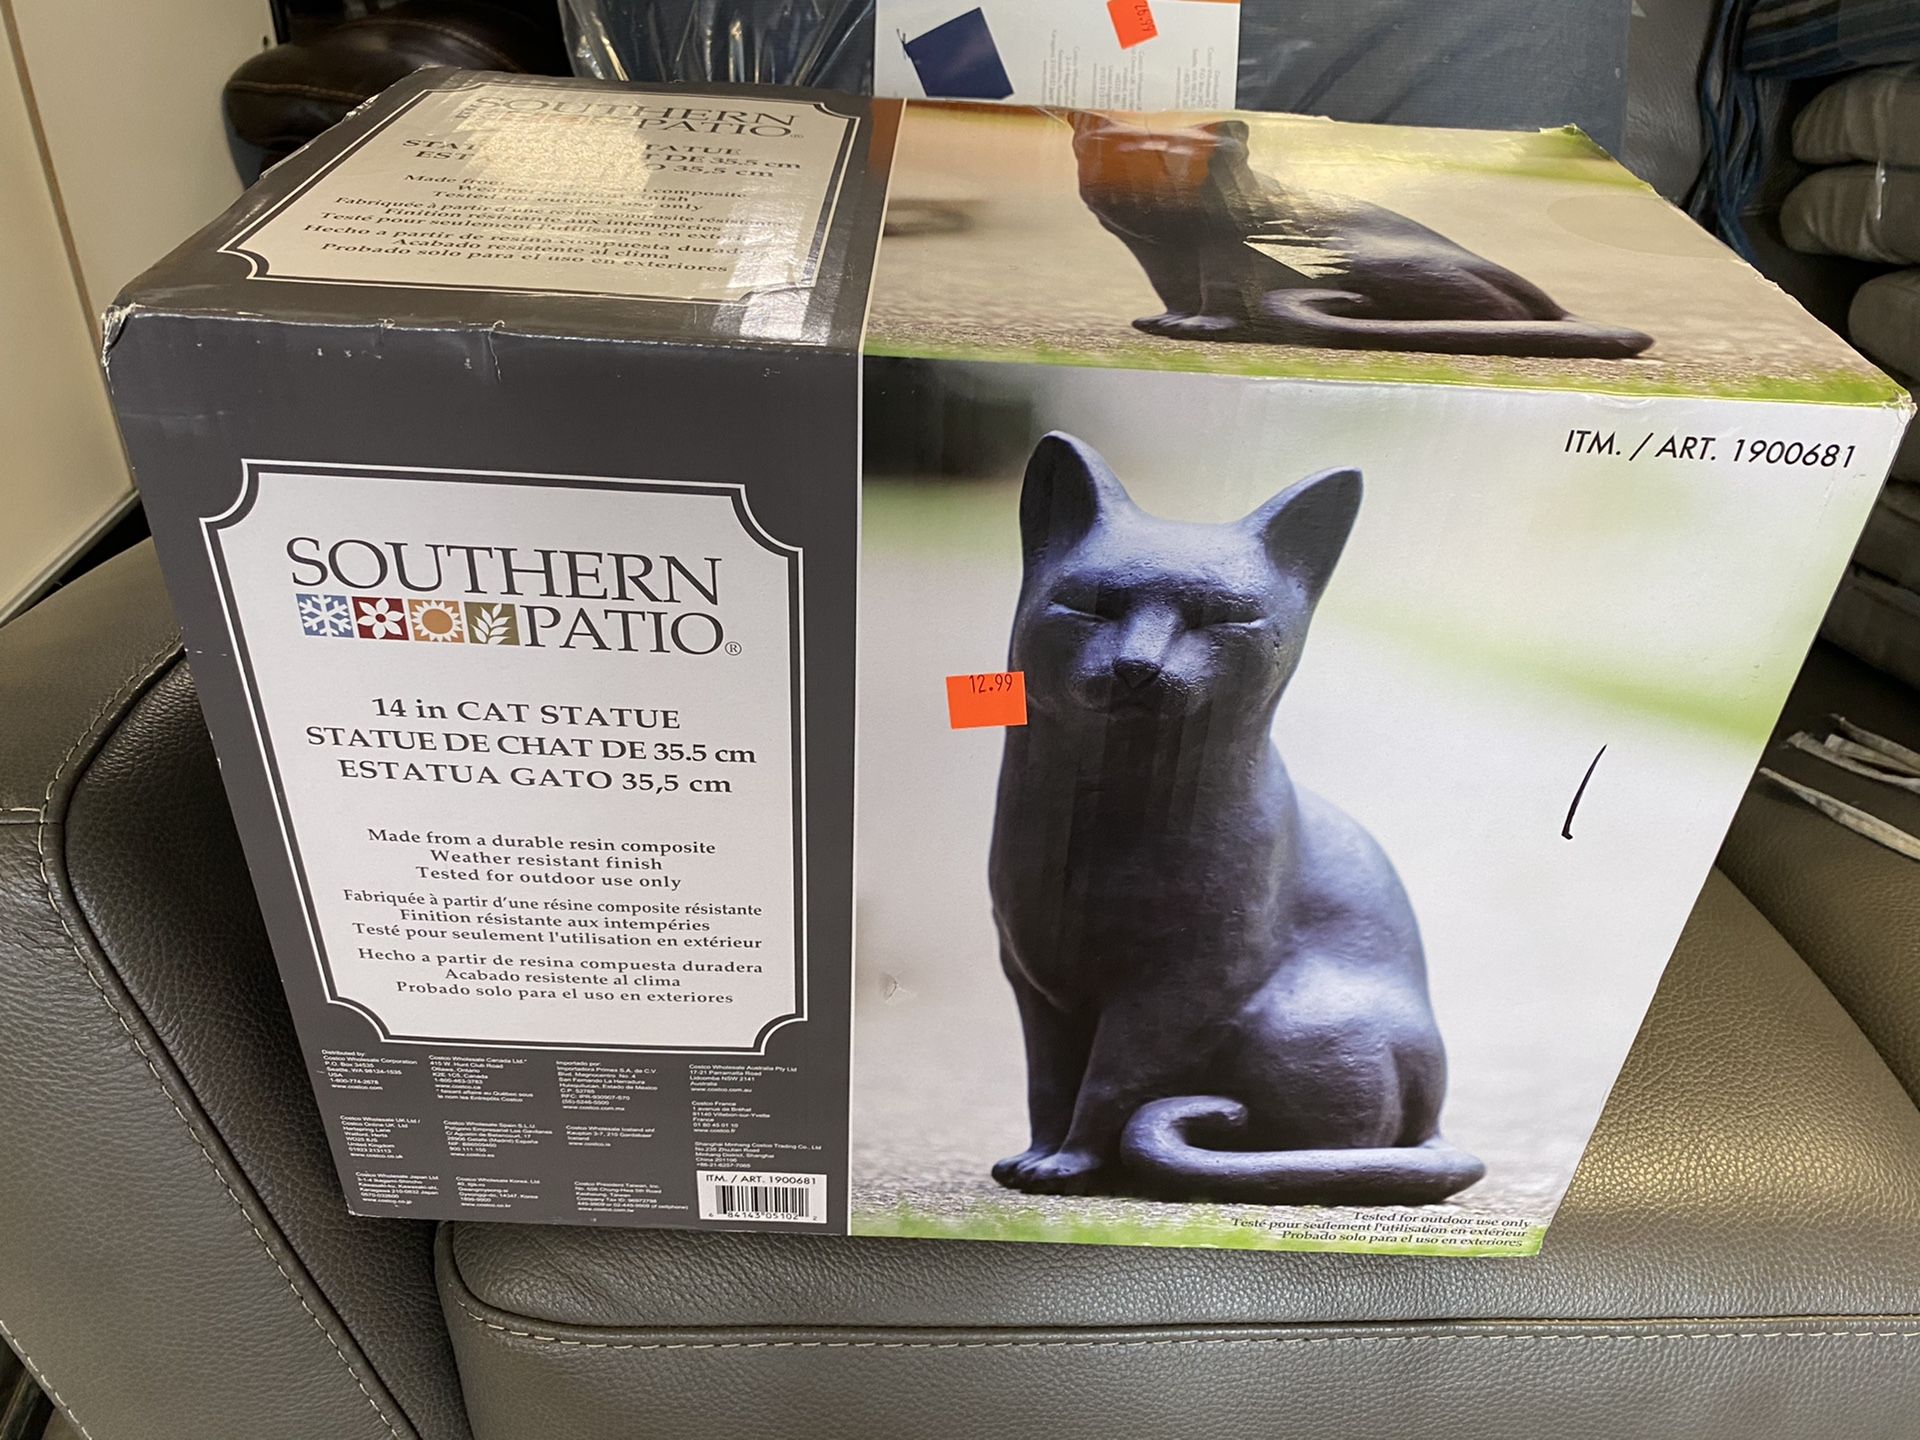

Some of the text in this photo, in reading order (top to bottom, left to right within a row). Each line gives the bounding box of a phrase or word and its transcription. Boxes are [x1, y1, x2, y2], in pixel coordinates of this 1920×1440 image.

[476, 97, 800, 126] SOUTHERN
[665, 155, 801, 170] DE 35.5 cm
[673, 165, 728, 175] 35,5
[735, 170, 774, 178] cm
[404, 174, 457, 183] Made
[385, 208, 462, 218] Finition
[433, 191, 496, 201] Tested
[659, 203, 704, 213] only
[440, 204, 492, 212] partir
[304, 224, 371, 235] Hecho
[392, 231, 454, 239] partir
[376, 217, 427, 225] pour
[429, 219, 532, 230] seulement
[321, 242, 411, 255] Probado
[417, 249, 462, 257] solo
[467, 252, 514, 260] para
[521, 253, 541, 261] el
[591, 257, 616, 265] en
[623, 260, 728, 272] exteriores
[392, 238, 670, 260] Acabado resistente al clima
[1565, 430, 1622, 456] ITM.
[1655, 435, 1717, 461] ART.
[1733, 438, 1856, 469] 1900681
[286, 537, 722, 606] SOUTHERN
[968, 673, 1013, 694] 12.99
[372, 698, 680, 729] 14 in CAT STATUE
[306, 726, 756, 763] STATUE DE CHAT DE 35.5 cm
[337, 759, 732, 794] ESTATUA GATO 35,5 cm
[368, 828, 715, 856] Made from a durable resin composite
[430, 849, 662, 870] Weather resistant finish
[415, 866, 681, 891] Tested for outdoor use only
[343, 889, 762, 916] Fabriquée à partir d'une résine composite résistante
[400, 909, 710, 933] Finition résistante aux intempéries
[352, 922, 762, 948] Testé pour seulement l'utilisation en extérieur
[358, 947, 762, 973] Hecho a partir de resina compuesta duradera
[445, 968, 680, 987] Acabado resistente al clima
[396, 981, 733, 1003] Probado solo para el uso en exteriores
[706, 1174, 727, 1183] ITM.
[741, 1175, 766, 1184] ART.
[769, 1176, 816, 1185] 1900681
[1268, 1221, 1302, 1230] pour
[1303, 1221, 1371, 1231] seulement
[1450, 1227, 1467, 1235] en
[1353, 1211, 1396, 1221] Tested
[1399, 1213, 1419, 1223] for
[1421, 1215, 1474, 1225] outdoor
[1501, 1219, 1531, 1230] only
[1282, 1230, 1337, 1241] Probado
[1339, 1233, 1367, 1241] solo
[1368, 1235, 1397, 1244] para
[1400, 1234, 1413, 1243] el
[1460, 1238, 1523, 1248] exteriores
